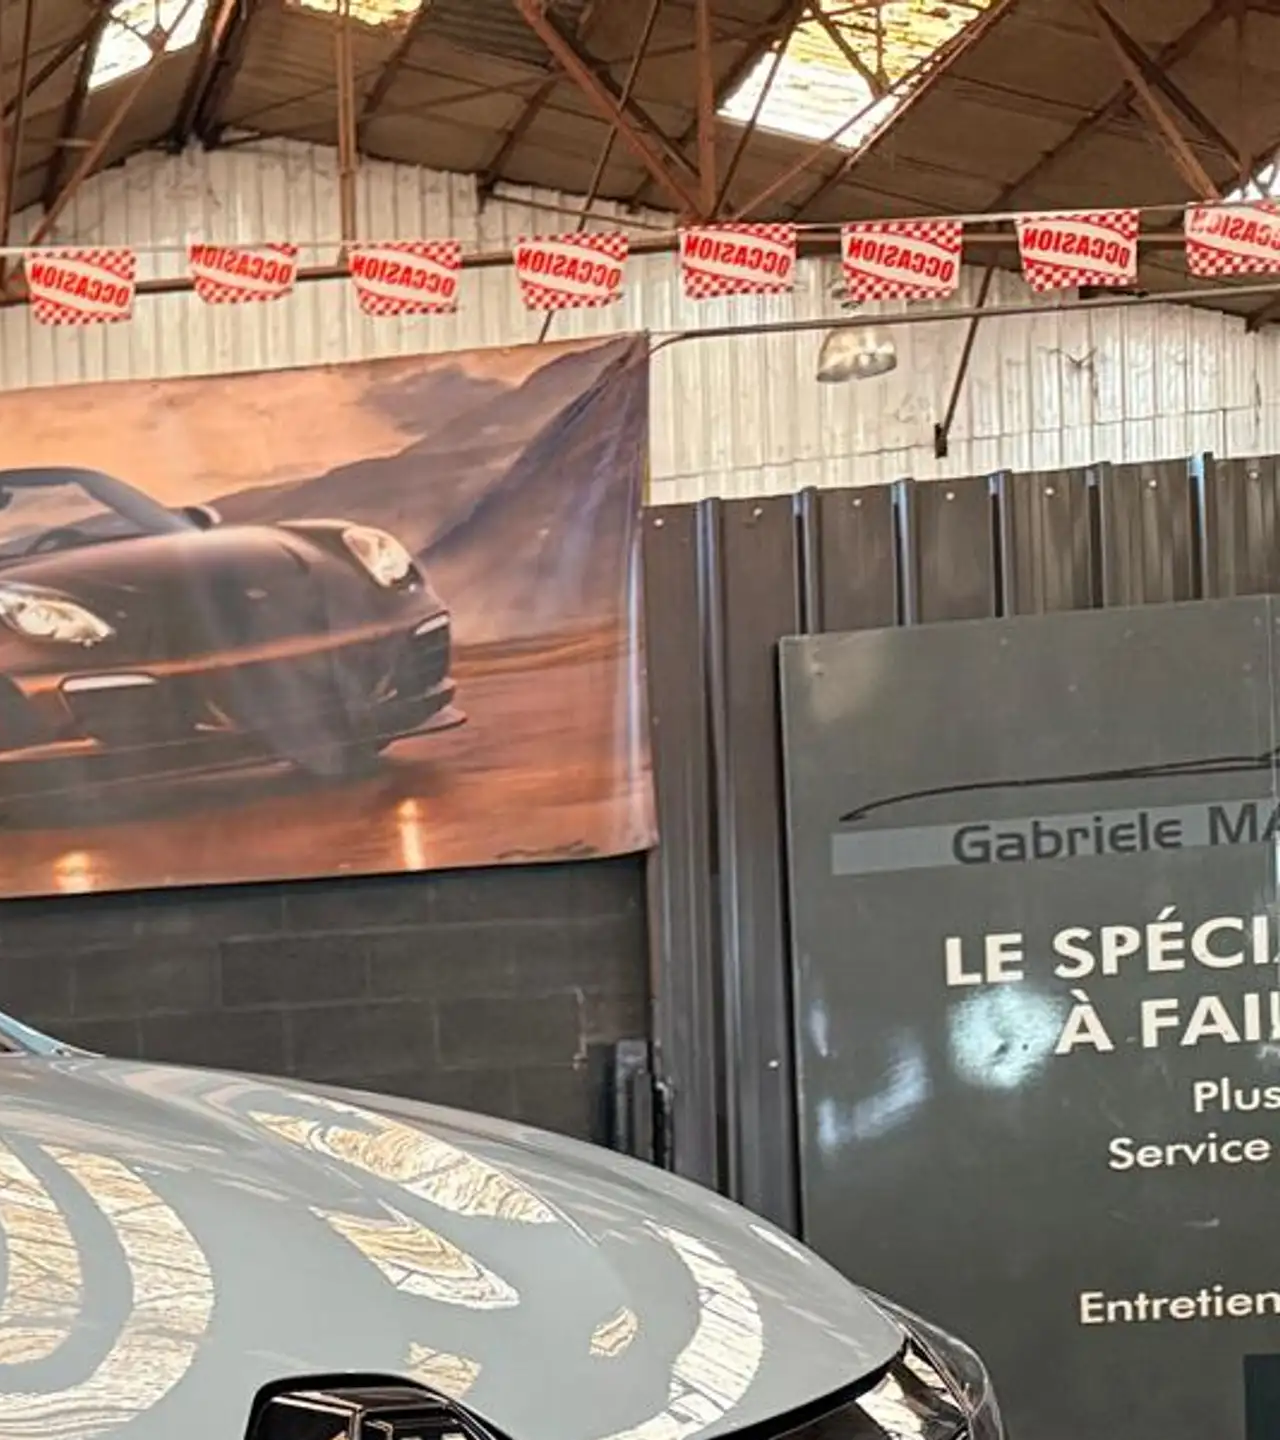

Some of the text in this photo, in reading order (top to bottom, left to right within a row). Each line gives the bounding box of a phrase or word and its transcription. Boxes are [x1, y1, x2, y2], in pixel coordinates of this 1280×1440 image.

[952, 812, 1182, 865] Gabriele
[945, 905, 1280, 987] LE SPÉCI
[1056, 990, 1280, 1054] À FAI
[1193, 1077, 1280, 1113] Plus
[1109, 1132, 1271, 1170] Service
[1080, 1284, 1280, 1324] Entretien
